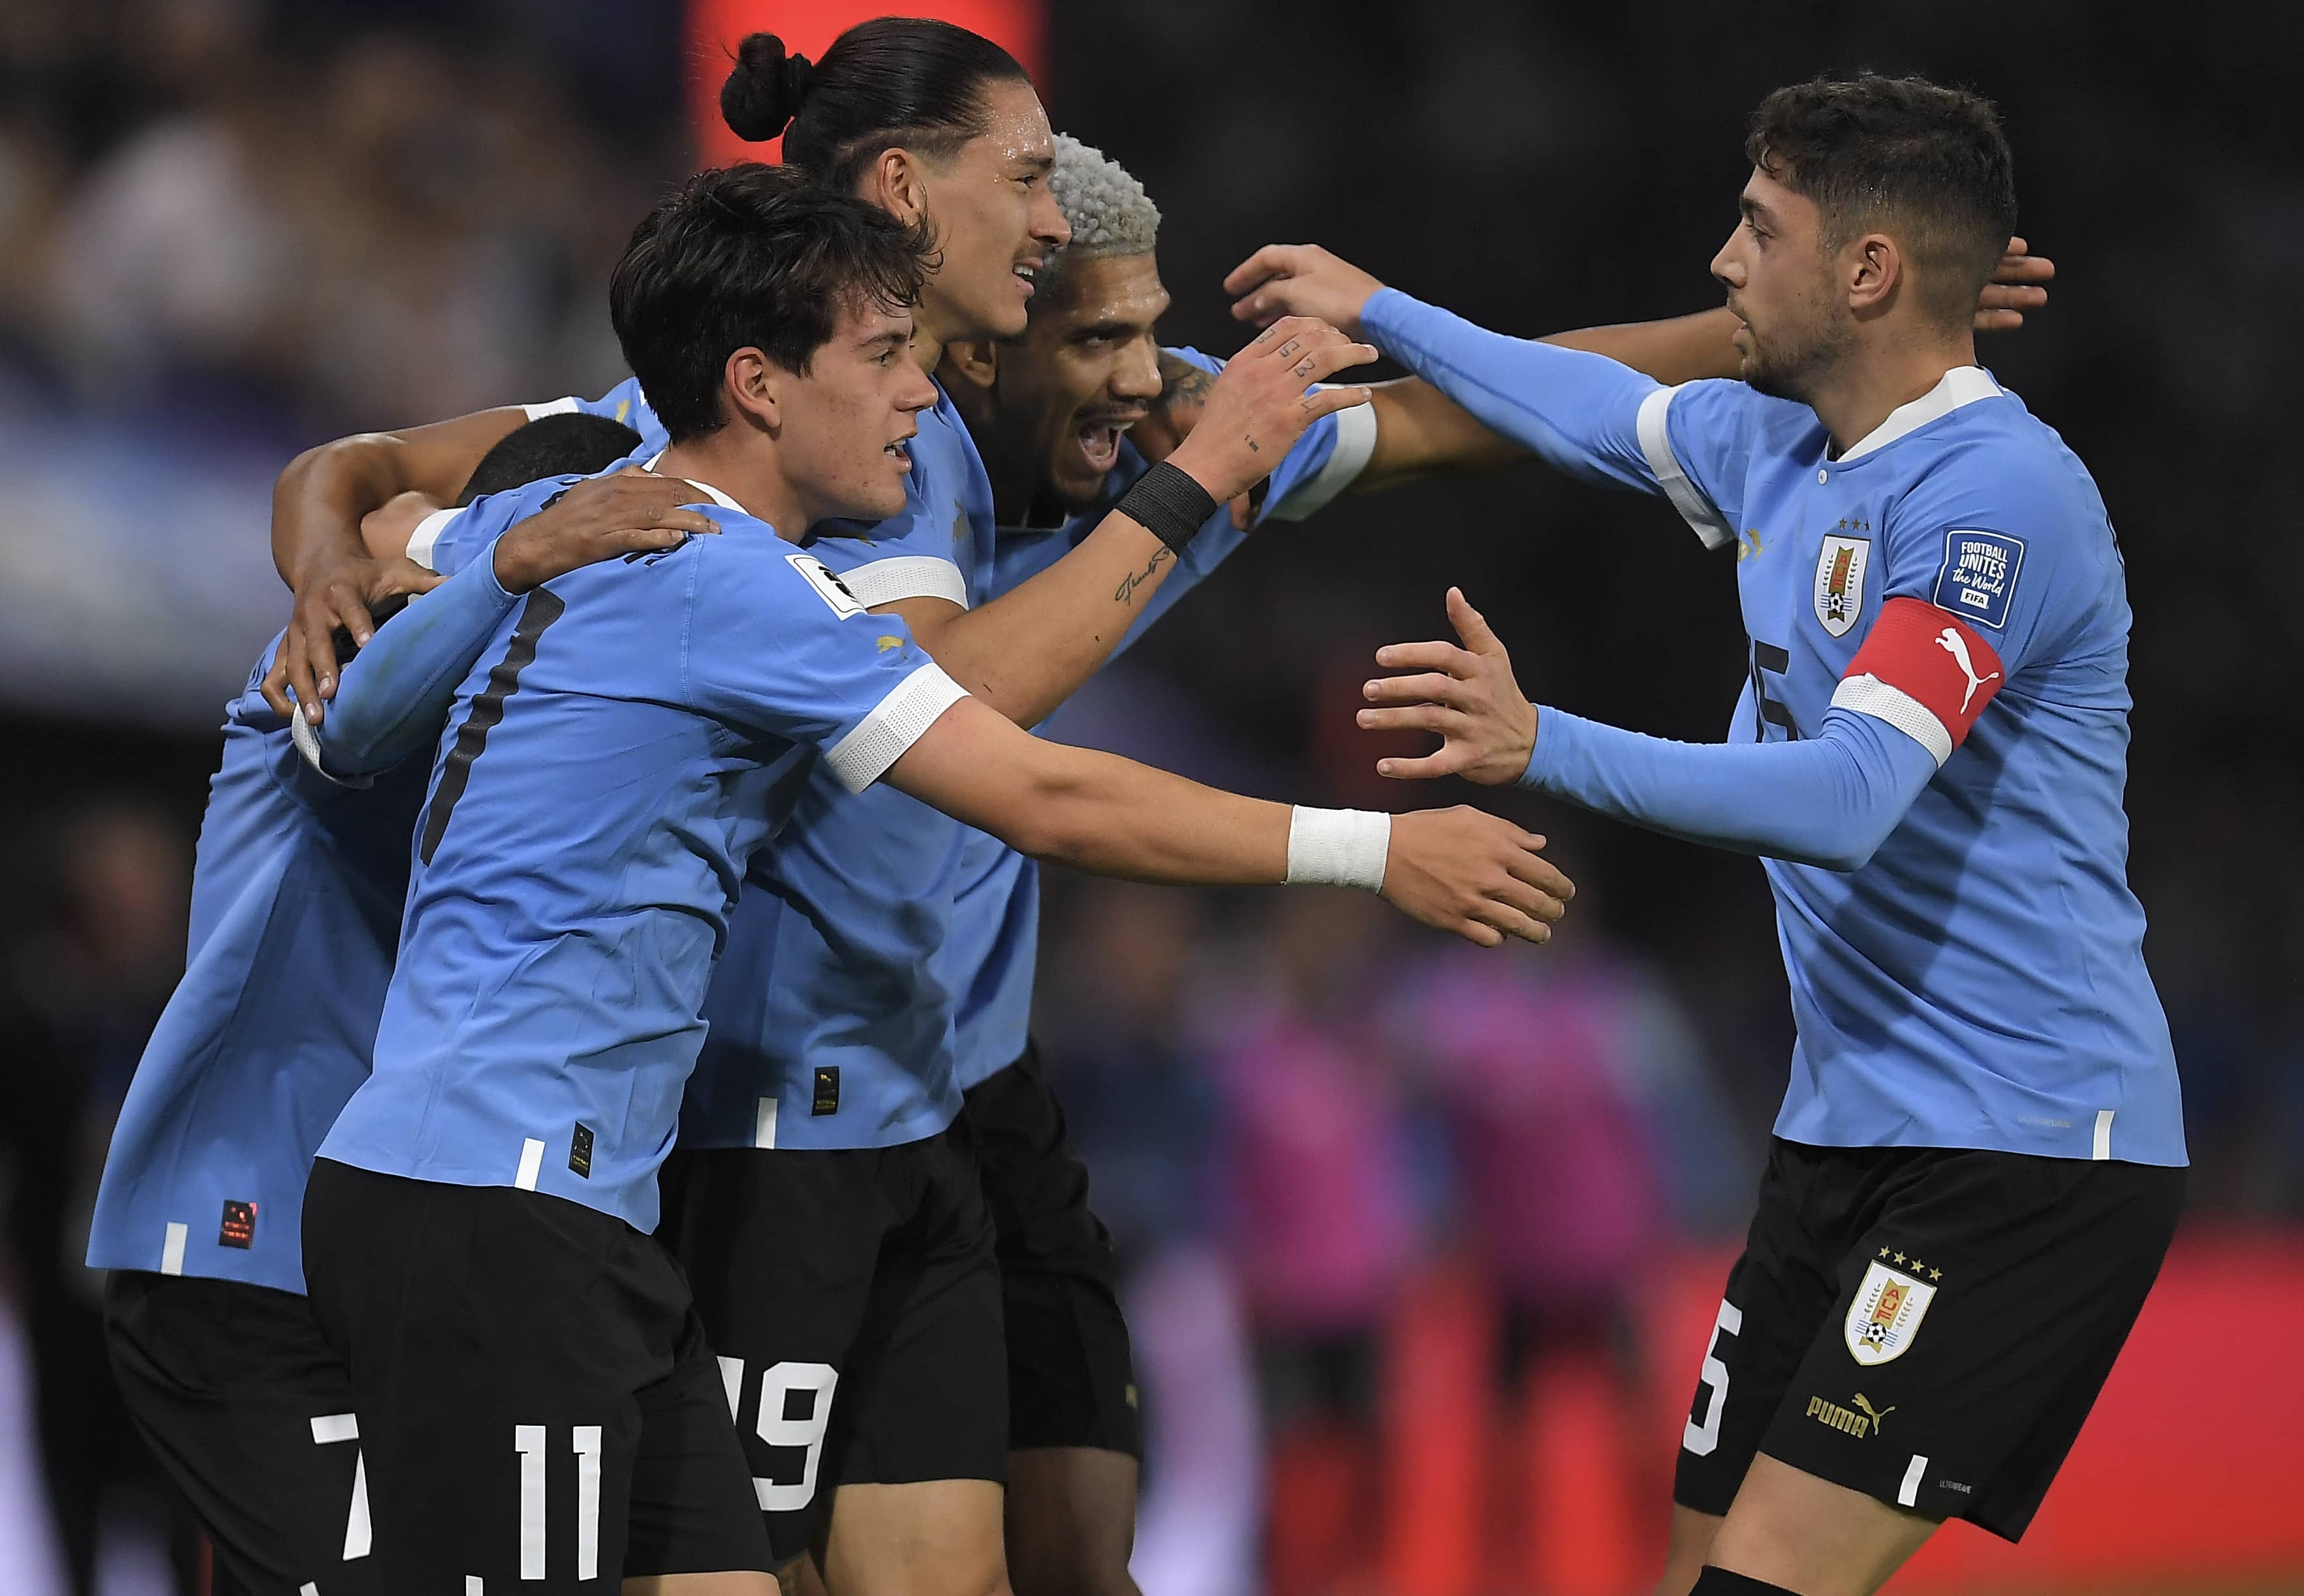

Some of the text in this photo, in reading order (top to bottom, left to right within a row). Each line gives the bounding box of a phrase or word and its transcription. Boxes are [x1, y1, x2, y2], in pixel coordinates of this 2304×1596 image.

[1959, 553, 2006, 580] UNITES
[1961, 542, 2008, 562] FOOTBALL
[1952, 568, 2005, 598] the World
[1965, 592, 1985, 605] FIFA
[716, 1355, 839, 1511] 9
[1806, 1395, 1870, 1439] PUMA
[310, 1413, 373, 1561] 7
[515, 1424, 602, 1581] 11
